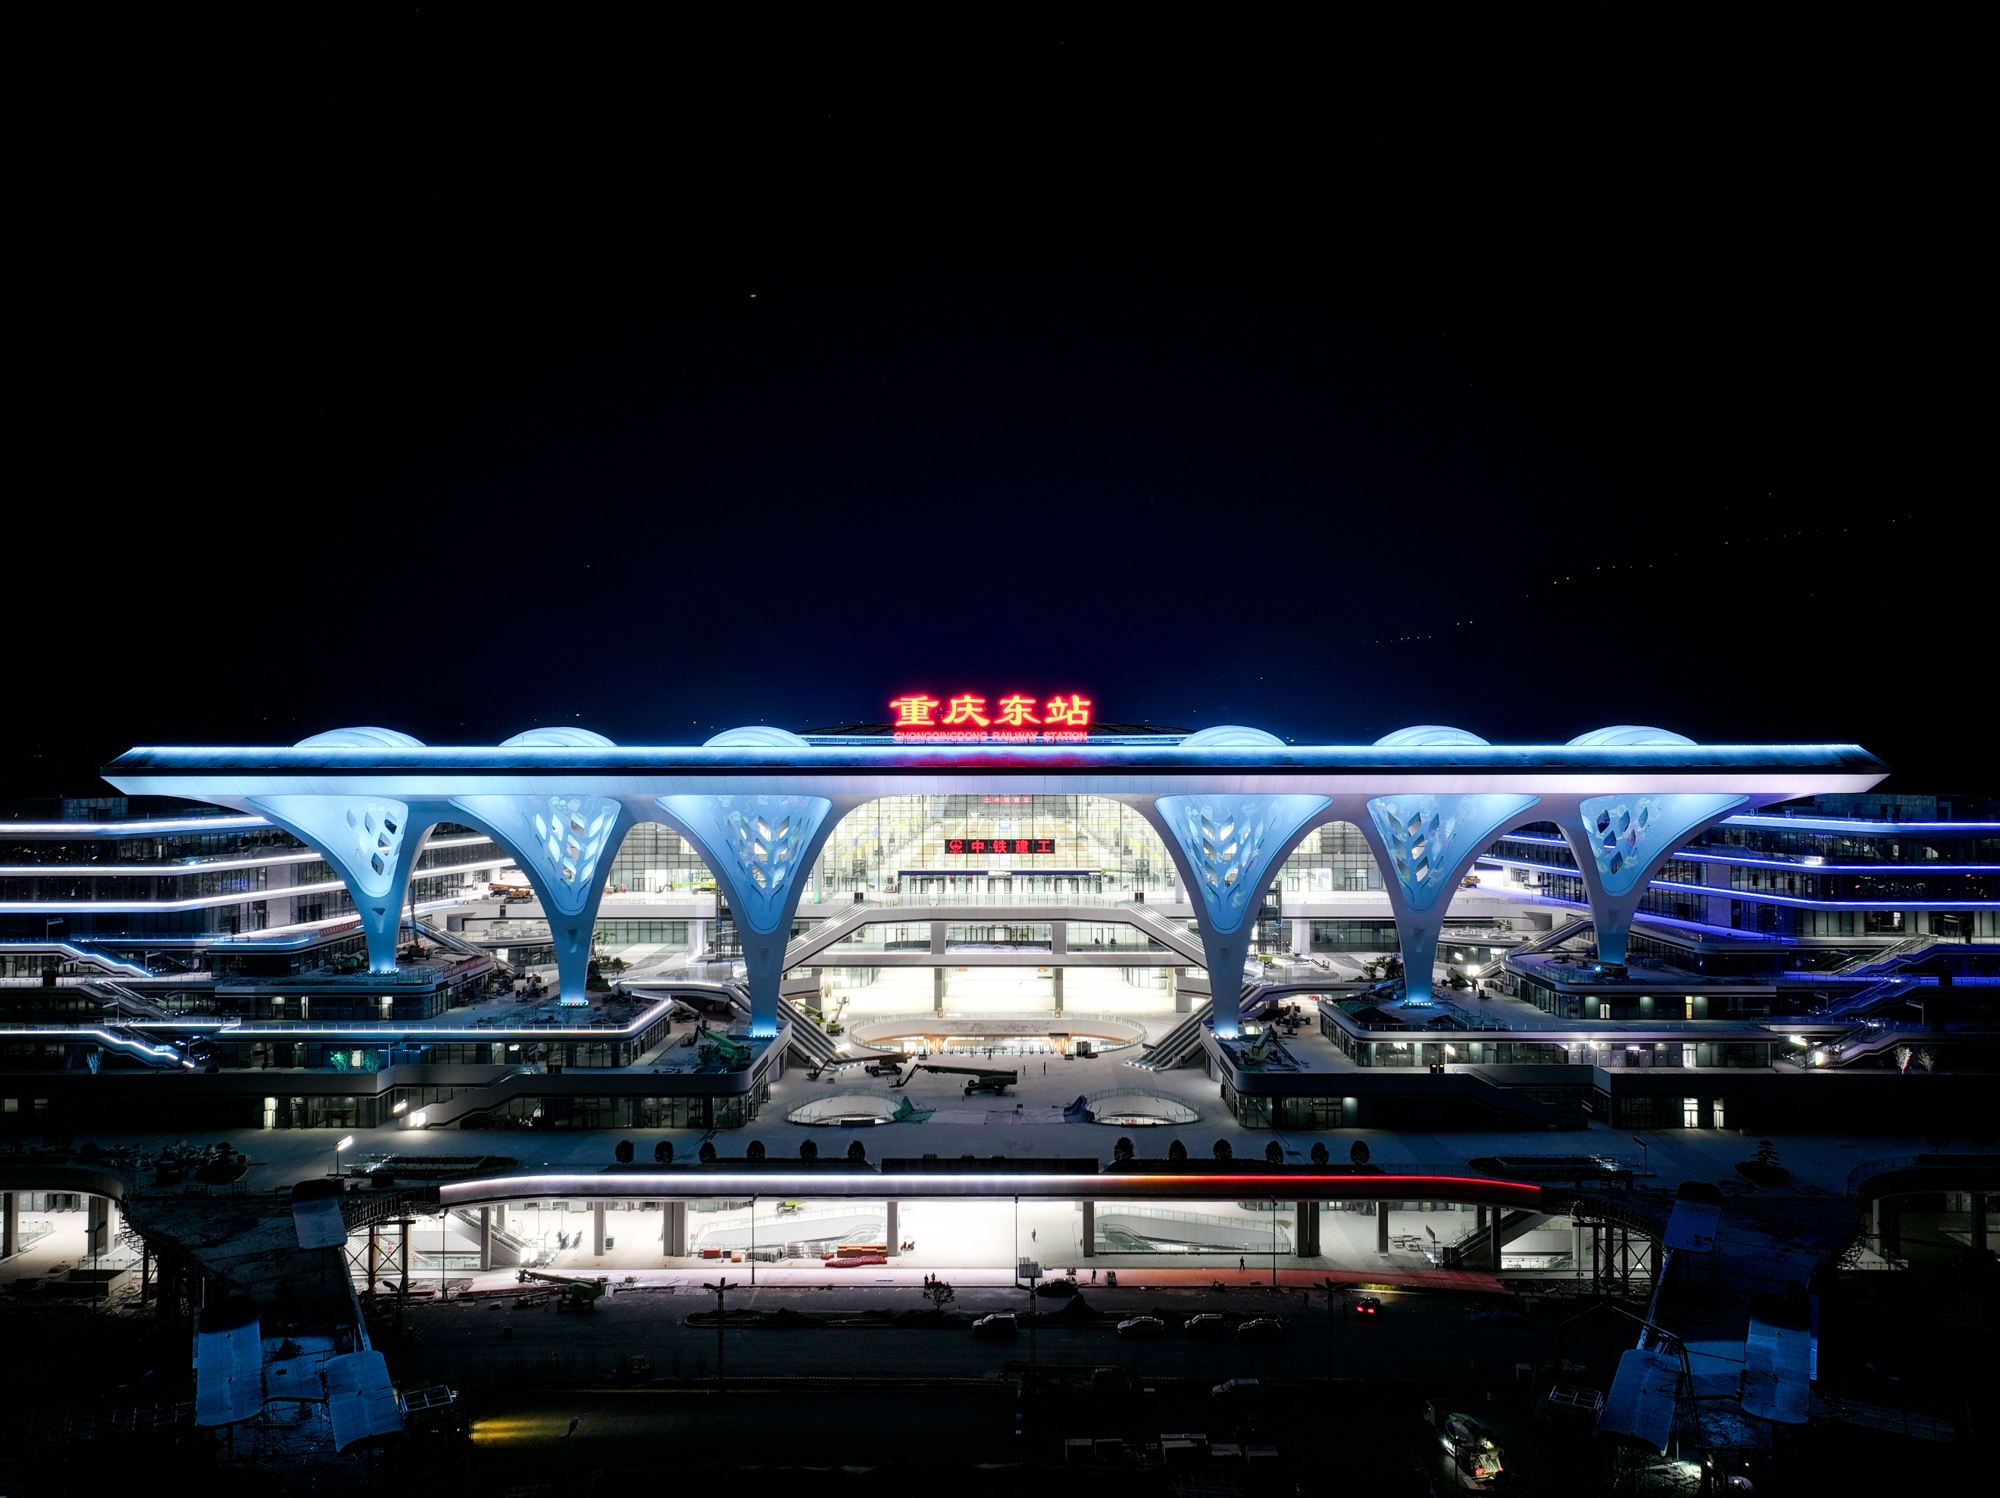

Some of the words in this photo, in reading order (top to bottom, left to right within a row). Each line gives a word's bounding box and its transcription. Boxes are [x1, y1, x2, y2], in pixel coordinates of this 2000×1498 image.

[889, 694, 1091, 727] 重庆东站
[894, 731, 988, 742] CHONGQINGDONG
[992, 731, 1038, 742] RAILWAY
[1043, 731, 1088, 742] STATION
[971, 839, 1051, 854] 中铁建工
